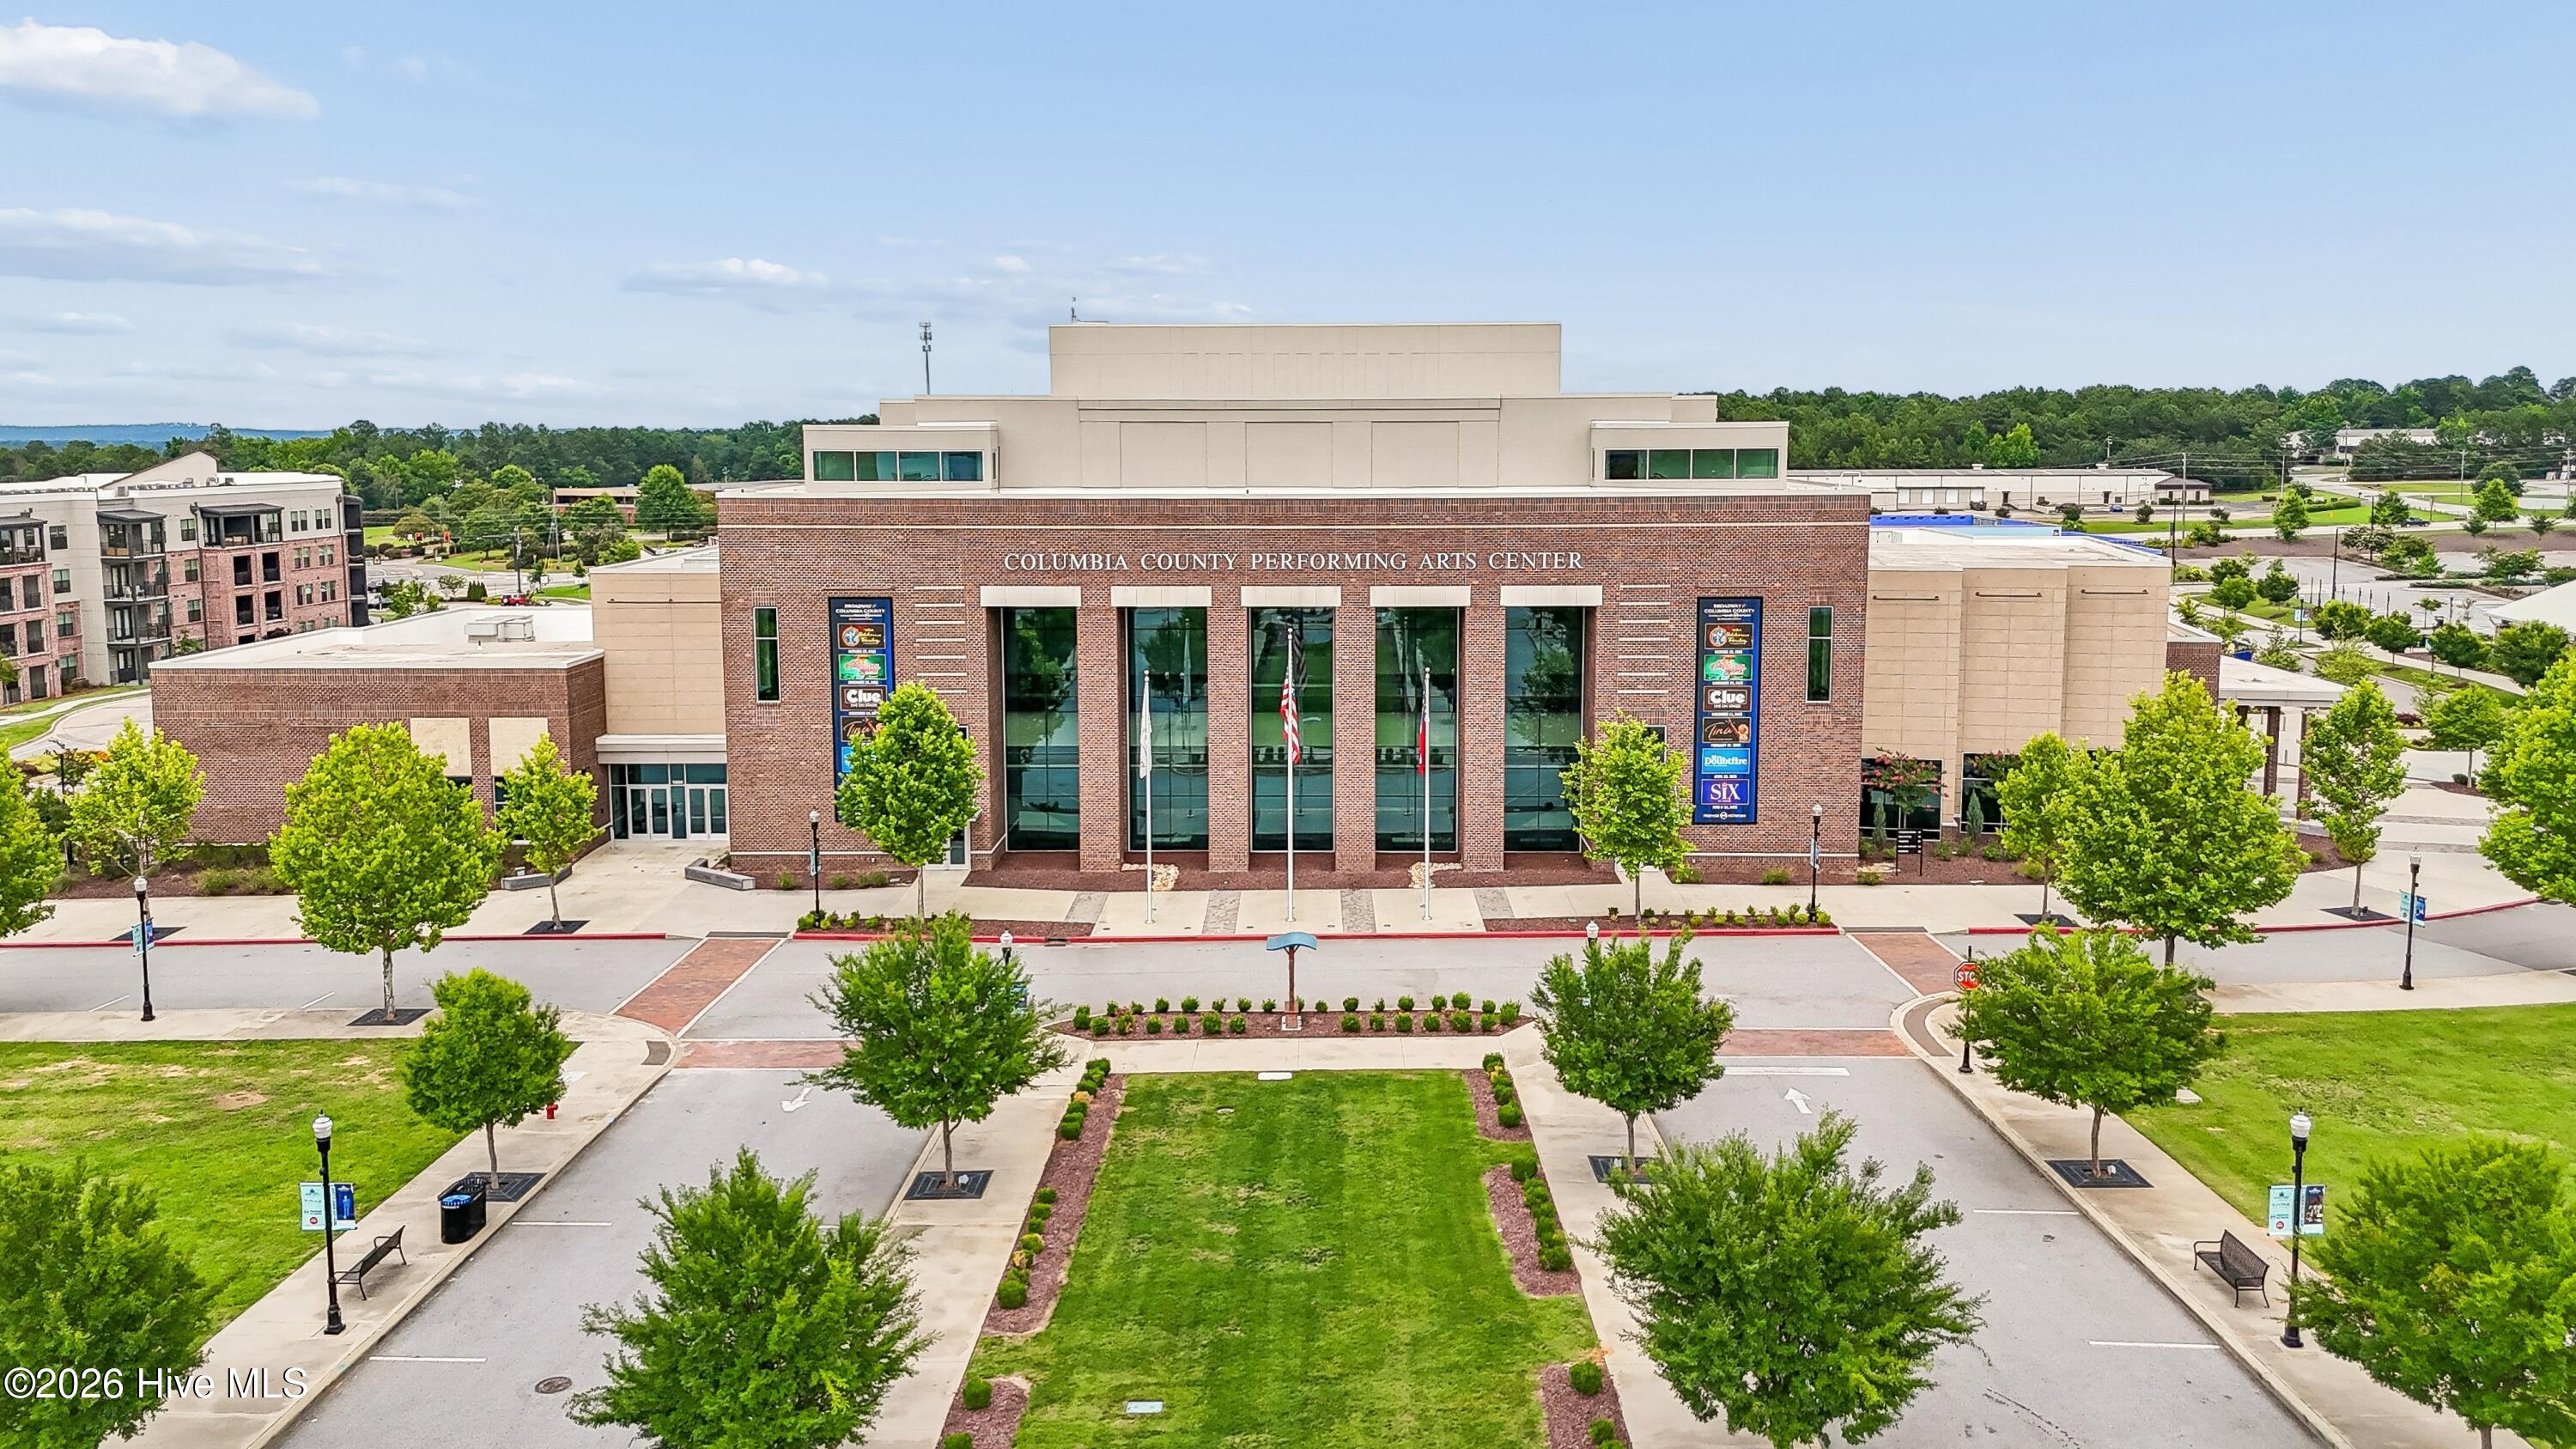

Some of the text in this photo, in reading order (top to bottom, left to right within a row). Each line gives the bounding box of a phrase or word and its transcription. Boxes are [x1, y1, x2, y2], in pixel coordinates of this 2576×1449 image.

[1004, 551, 1584, 571] COLUMBIA COUNTY PERFORMING ARTS CENTER
[846, 689, 881, 703] Clue
[1710, 690, 1746, 703] Clue
[1704, 721, 1733, 739] Tina
[1704, 755, 1748, 765] Doubtfire
[1710, 782, 1741, 801] SIX
[1958, 971, 1976, 982] STO
